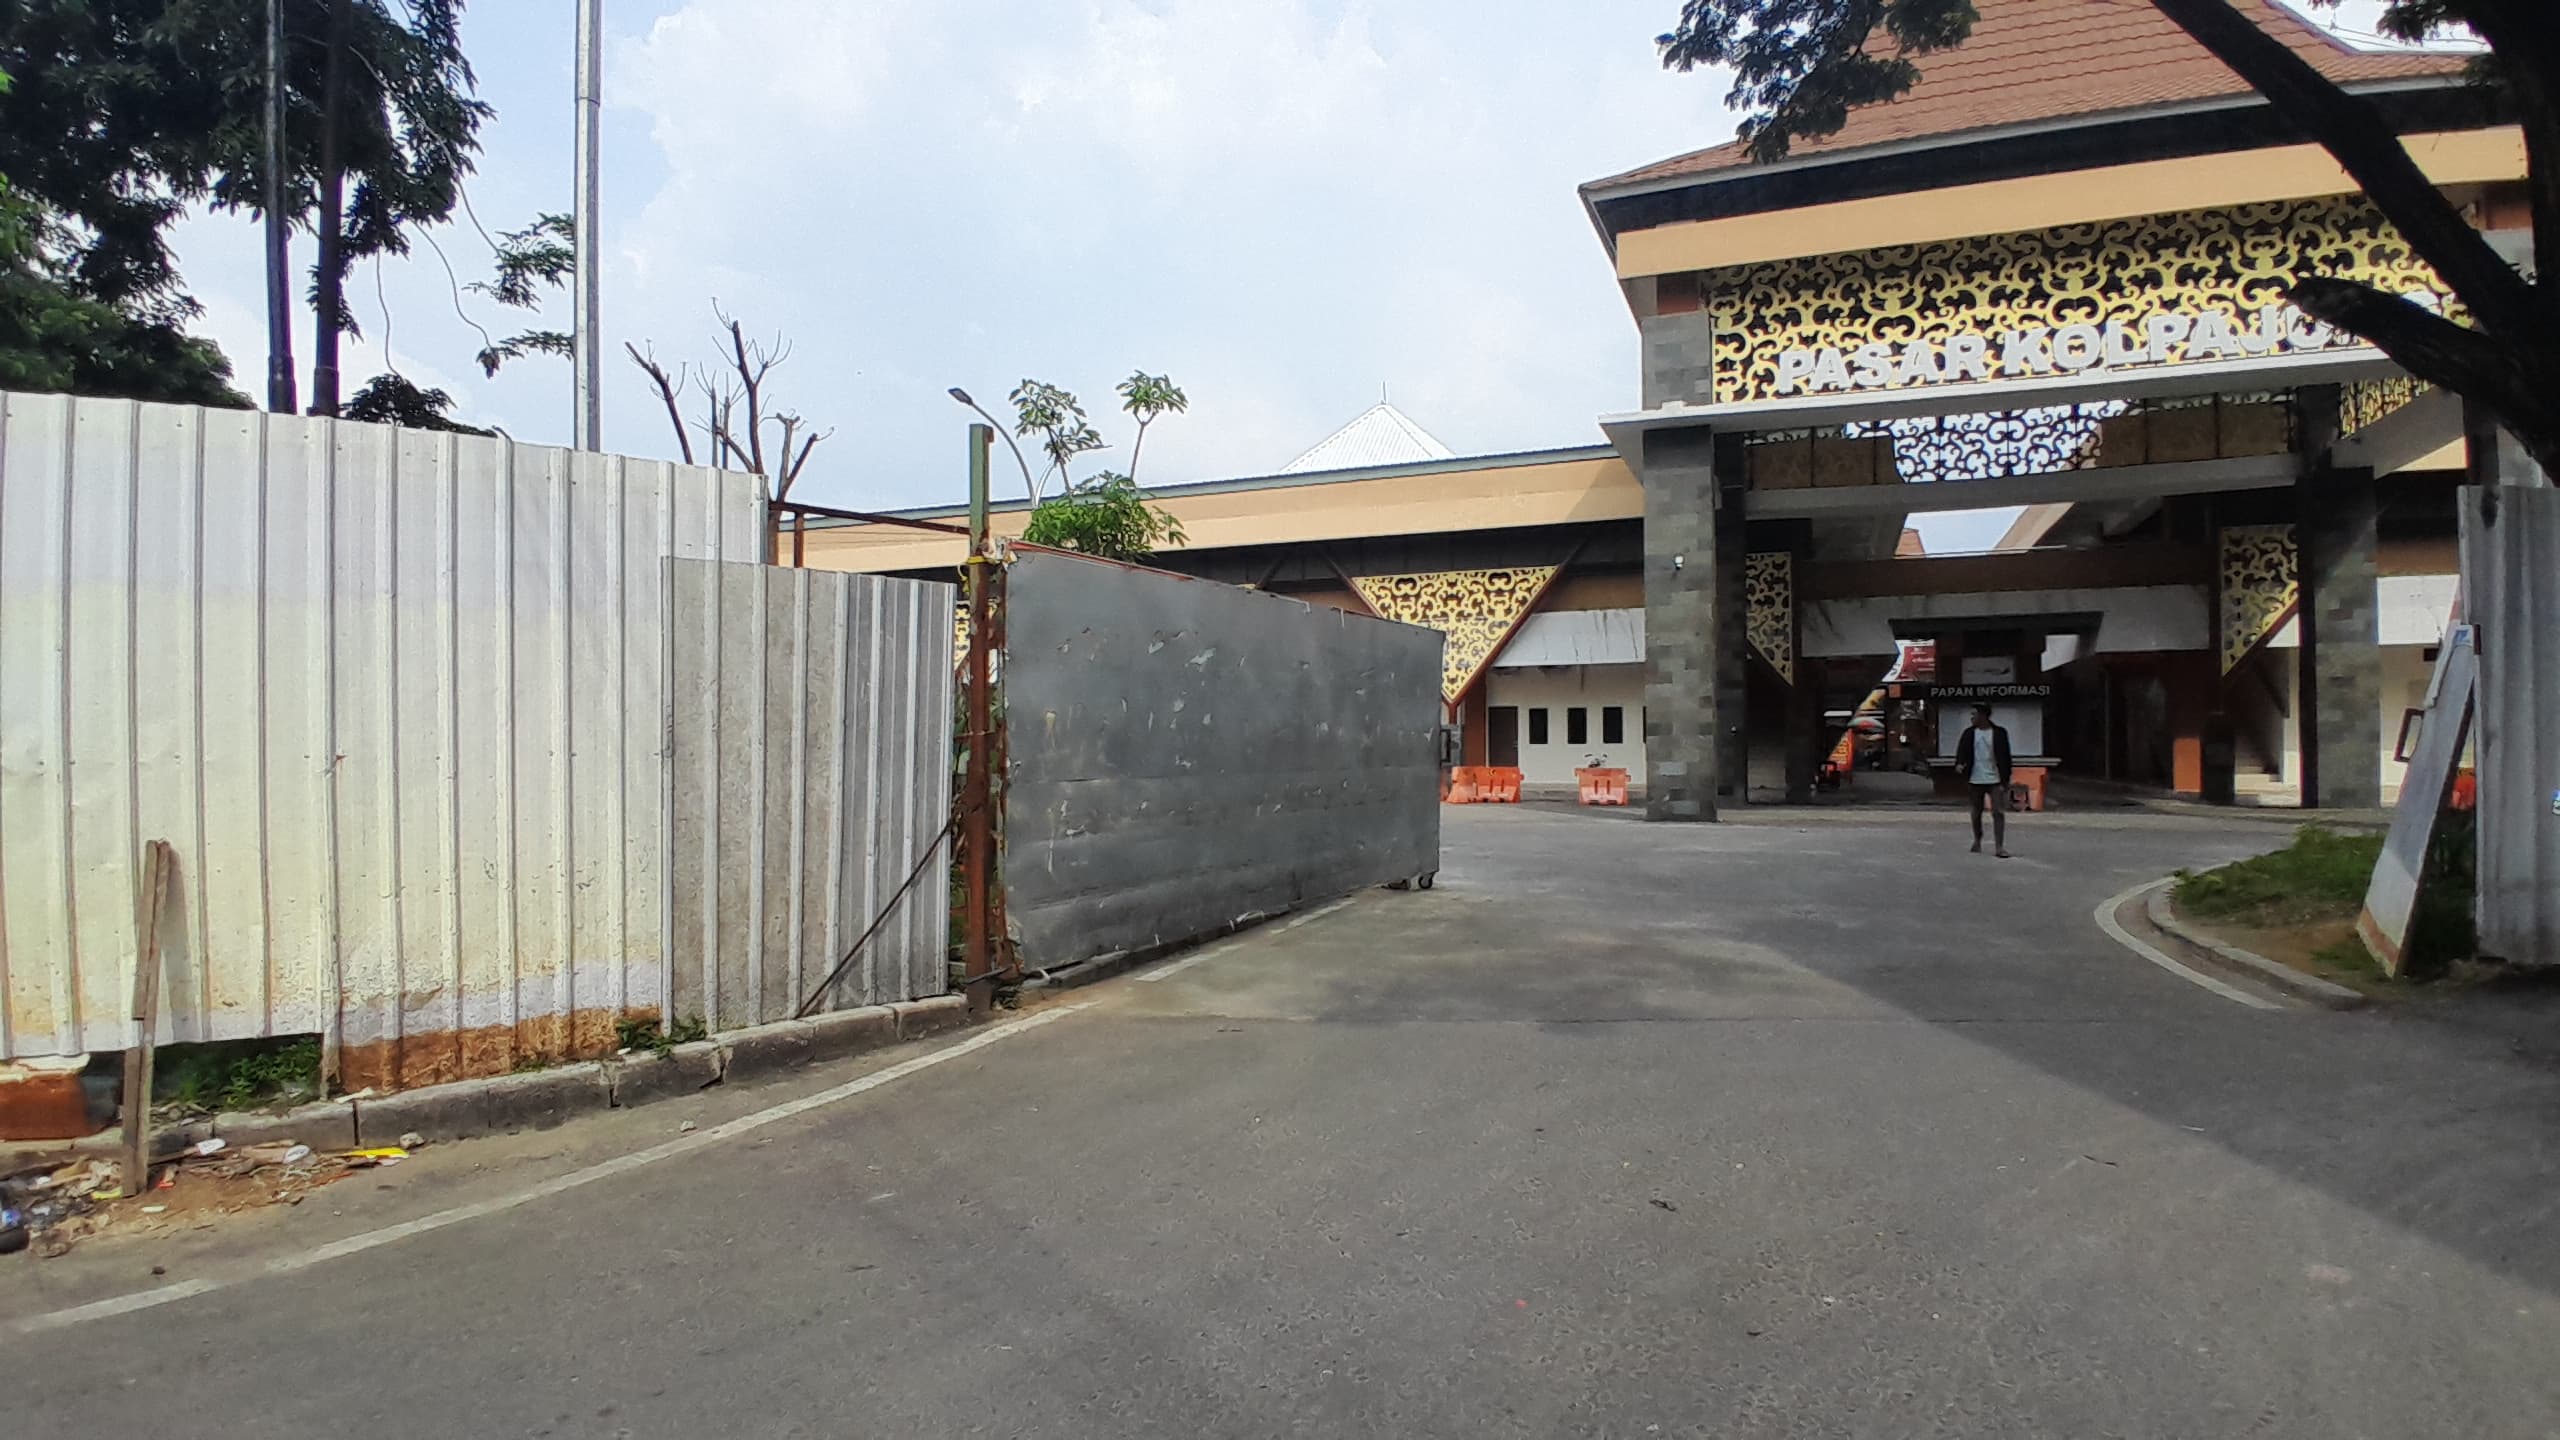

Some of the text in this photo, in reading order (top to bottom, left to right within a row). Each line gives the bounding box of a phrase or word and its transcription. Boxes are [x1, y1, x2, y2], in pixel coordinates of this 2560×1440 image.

[1778, 335, 1986, 393] PASAR
[1930, 685, 2050, 697] PAPAN INFORMASI
